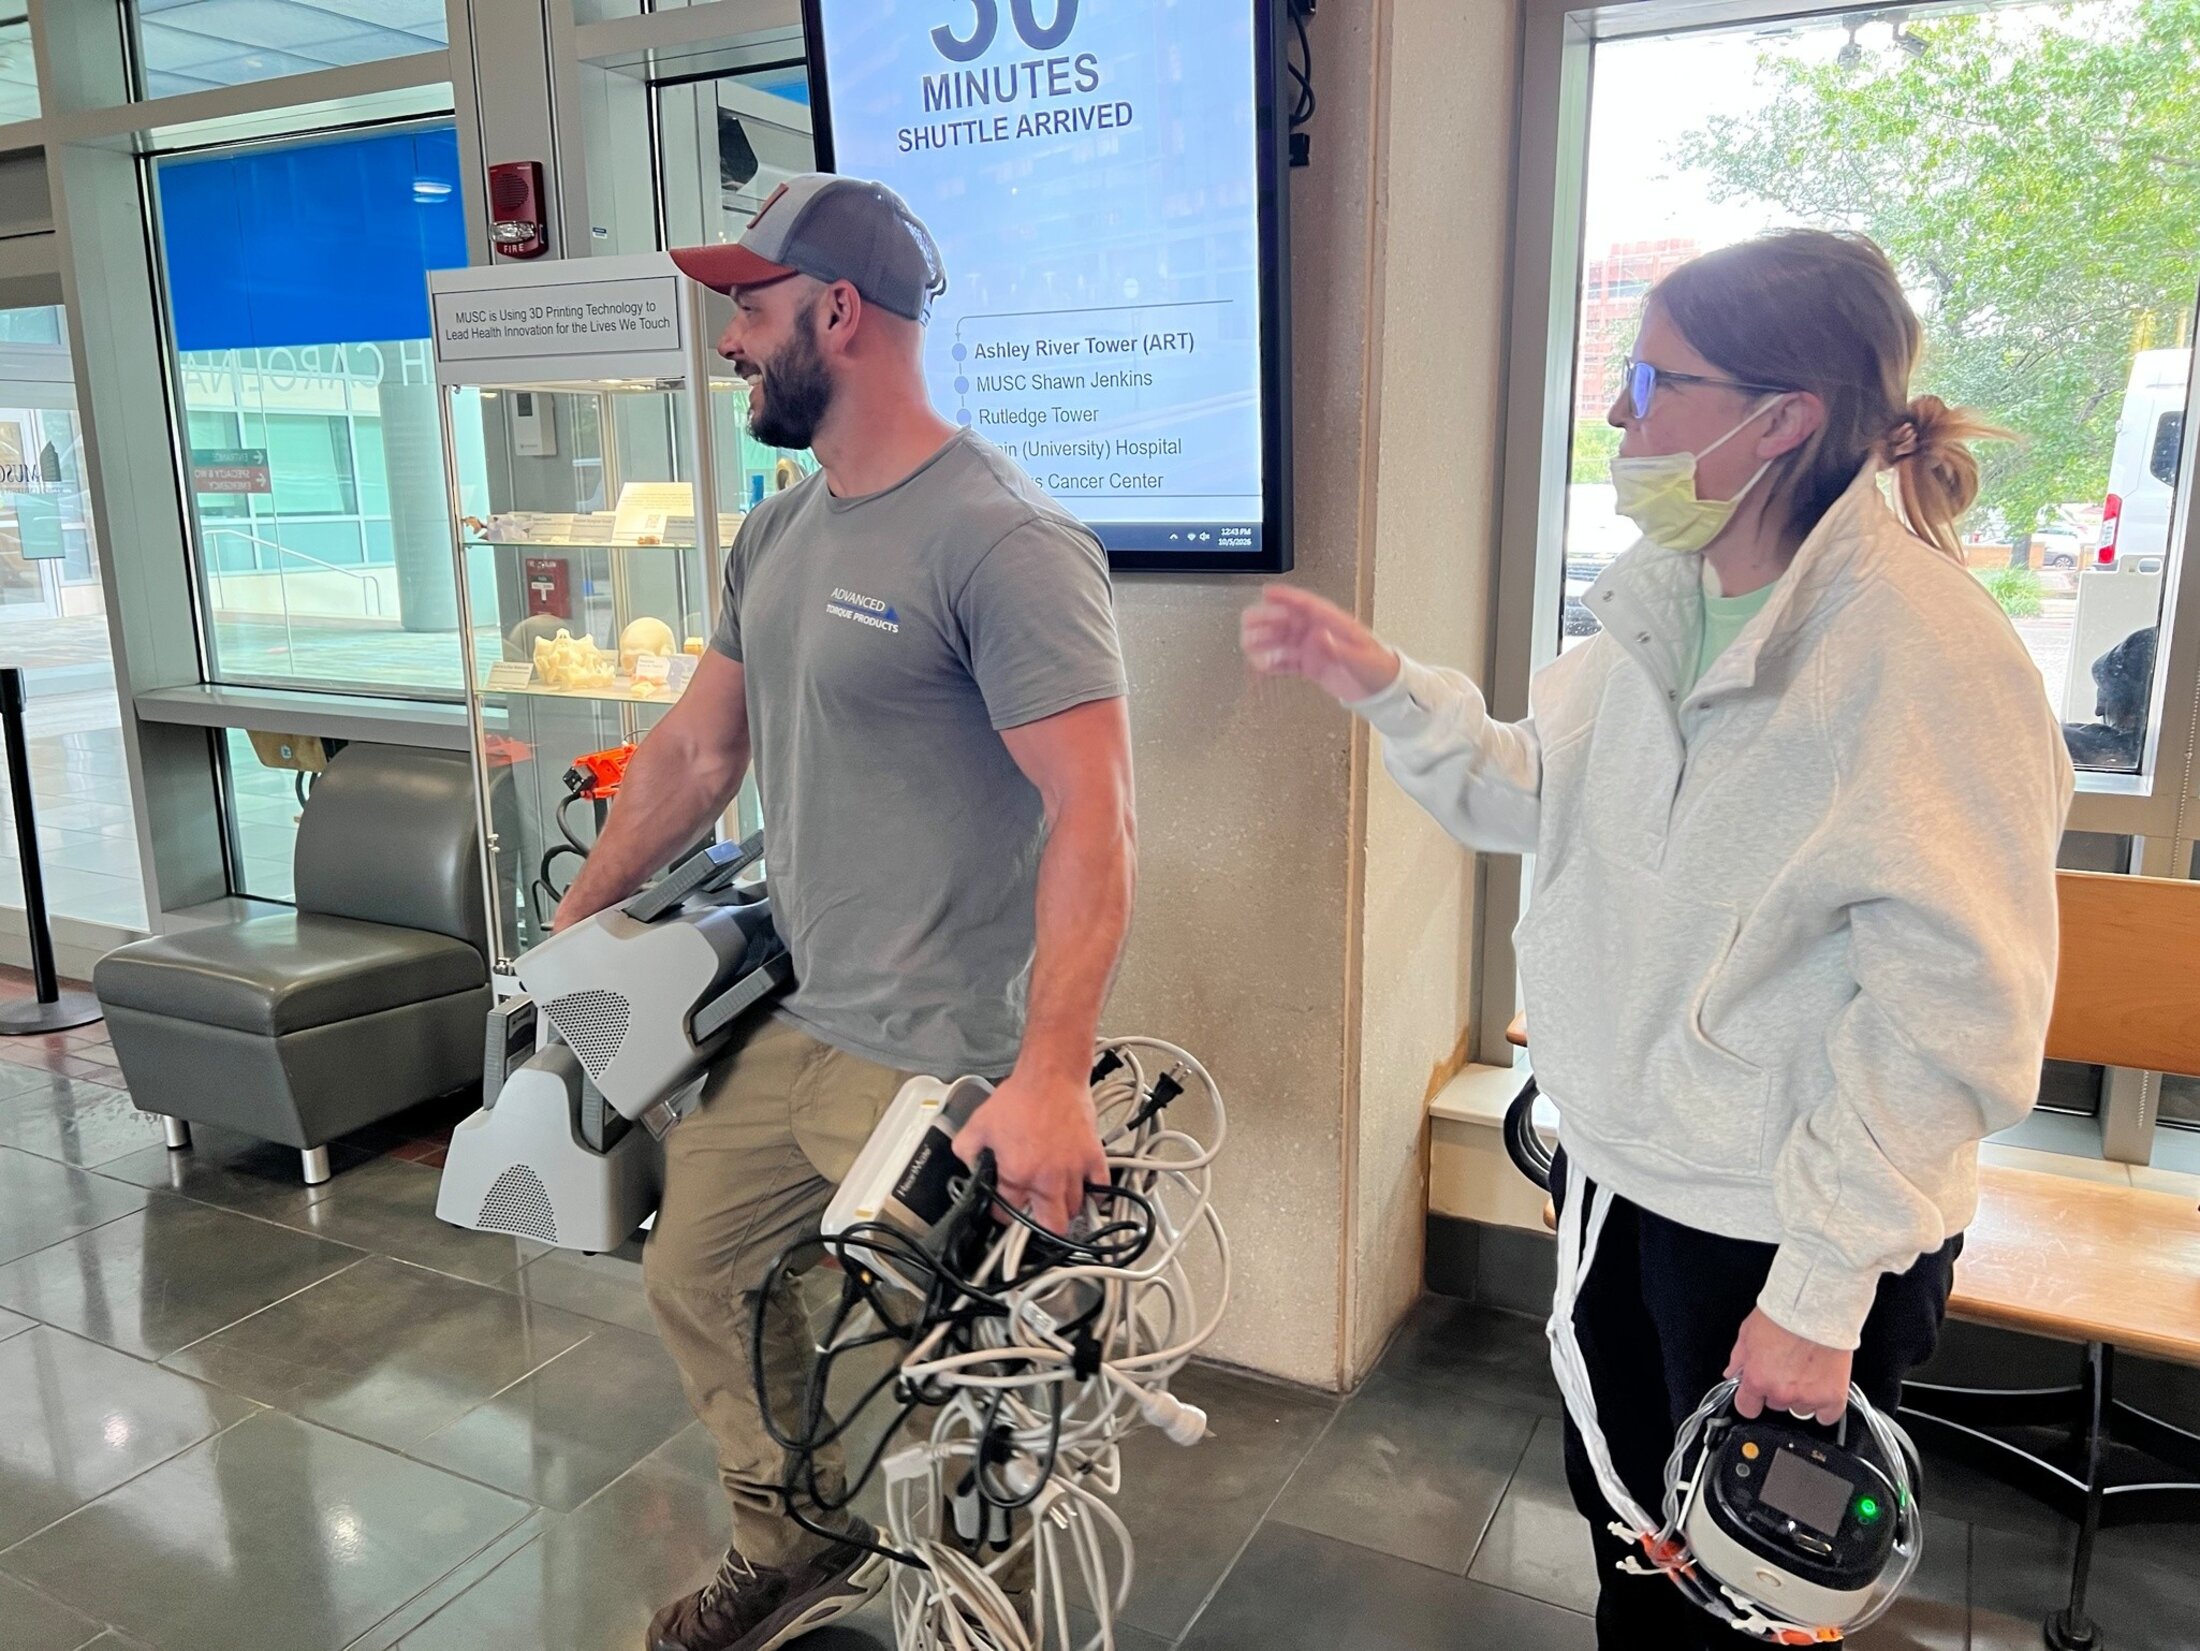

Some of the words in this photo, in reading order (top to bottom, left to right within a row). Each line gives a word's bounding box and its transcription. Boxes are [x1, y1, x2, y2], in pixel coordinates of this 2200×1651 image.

[922, 53, 1099, 112] MINUTES
[897, 116, 1009, 152] SHUTTLE
[1016, 102, 1133, 138] ARRIVED
[503, 243, 525, 254] FIRE
[455, 310, 487, 324] MUSC
[489, 310, 498, 322] is
[500, 308, 527, 323] Using
[529, 307, 543, 319] 3D
[546, 304, 583, 319] Printing
[586, 301, 643, 316] Technology
[646, 301, 656, 313] to
[446, 329, 469, 341] Lead
[471, 327, 502, 339] Health
[504, 324, 554, 337] Innovation
[556, 323, 570, 334] for
[572, 321, 588, 333] the
[590, 320, 617, 333] Lives
[619, 318, 637, 330] We
[639, 317, 671, 330] Touch
[974, 341, 1030, 362] Ashley
[1035, 339, 1081, 356] River
[1085, 337, 1138, 354] Tower
[1143, 332, 1195, 356] (ART)
[976, 374, 1026, 393] MUSC
[1031, 373, 1086, 391] Shawn
[1090, 370, 1153, 388] Jenkins
[979, 409, 1048, 428] Rutledge
[1052, 406, 1100, 423] Tower
[998, 441, 1018, 458] in
[1022, 439, 1112, 461] (University)
[1116, 438, 1182, 459] Hospital
[1047, 473, 1105, 490] Cancer
[1109, 472, 1164, 489] Center
[1240, 528, 1252, 536] PM
[830, 587, 886, 612] ADVANCED
[826, 604, 853, 619] TORQUE
[852, 612, 899, 633] PRODUCTS
